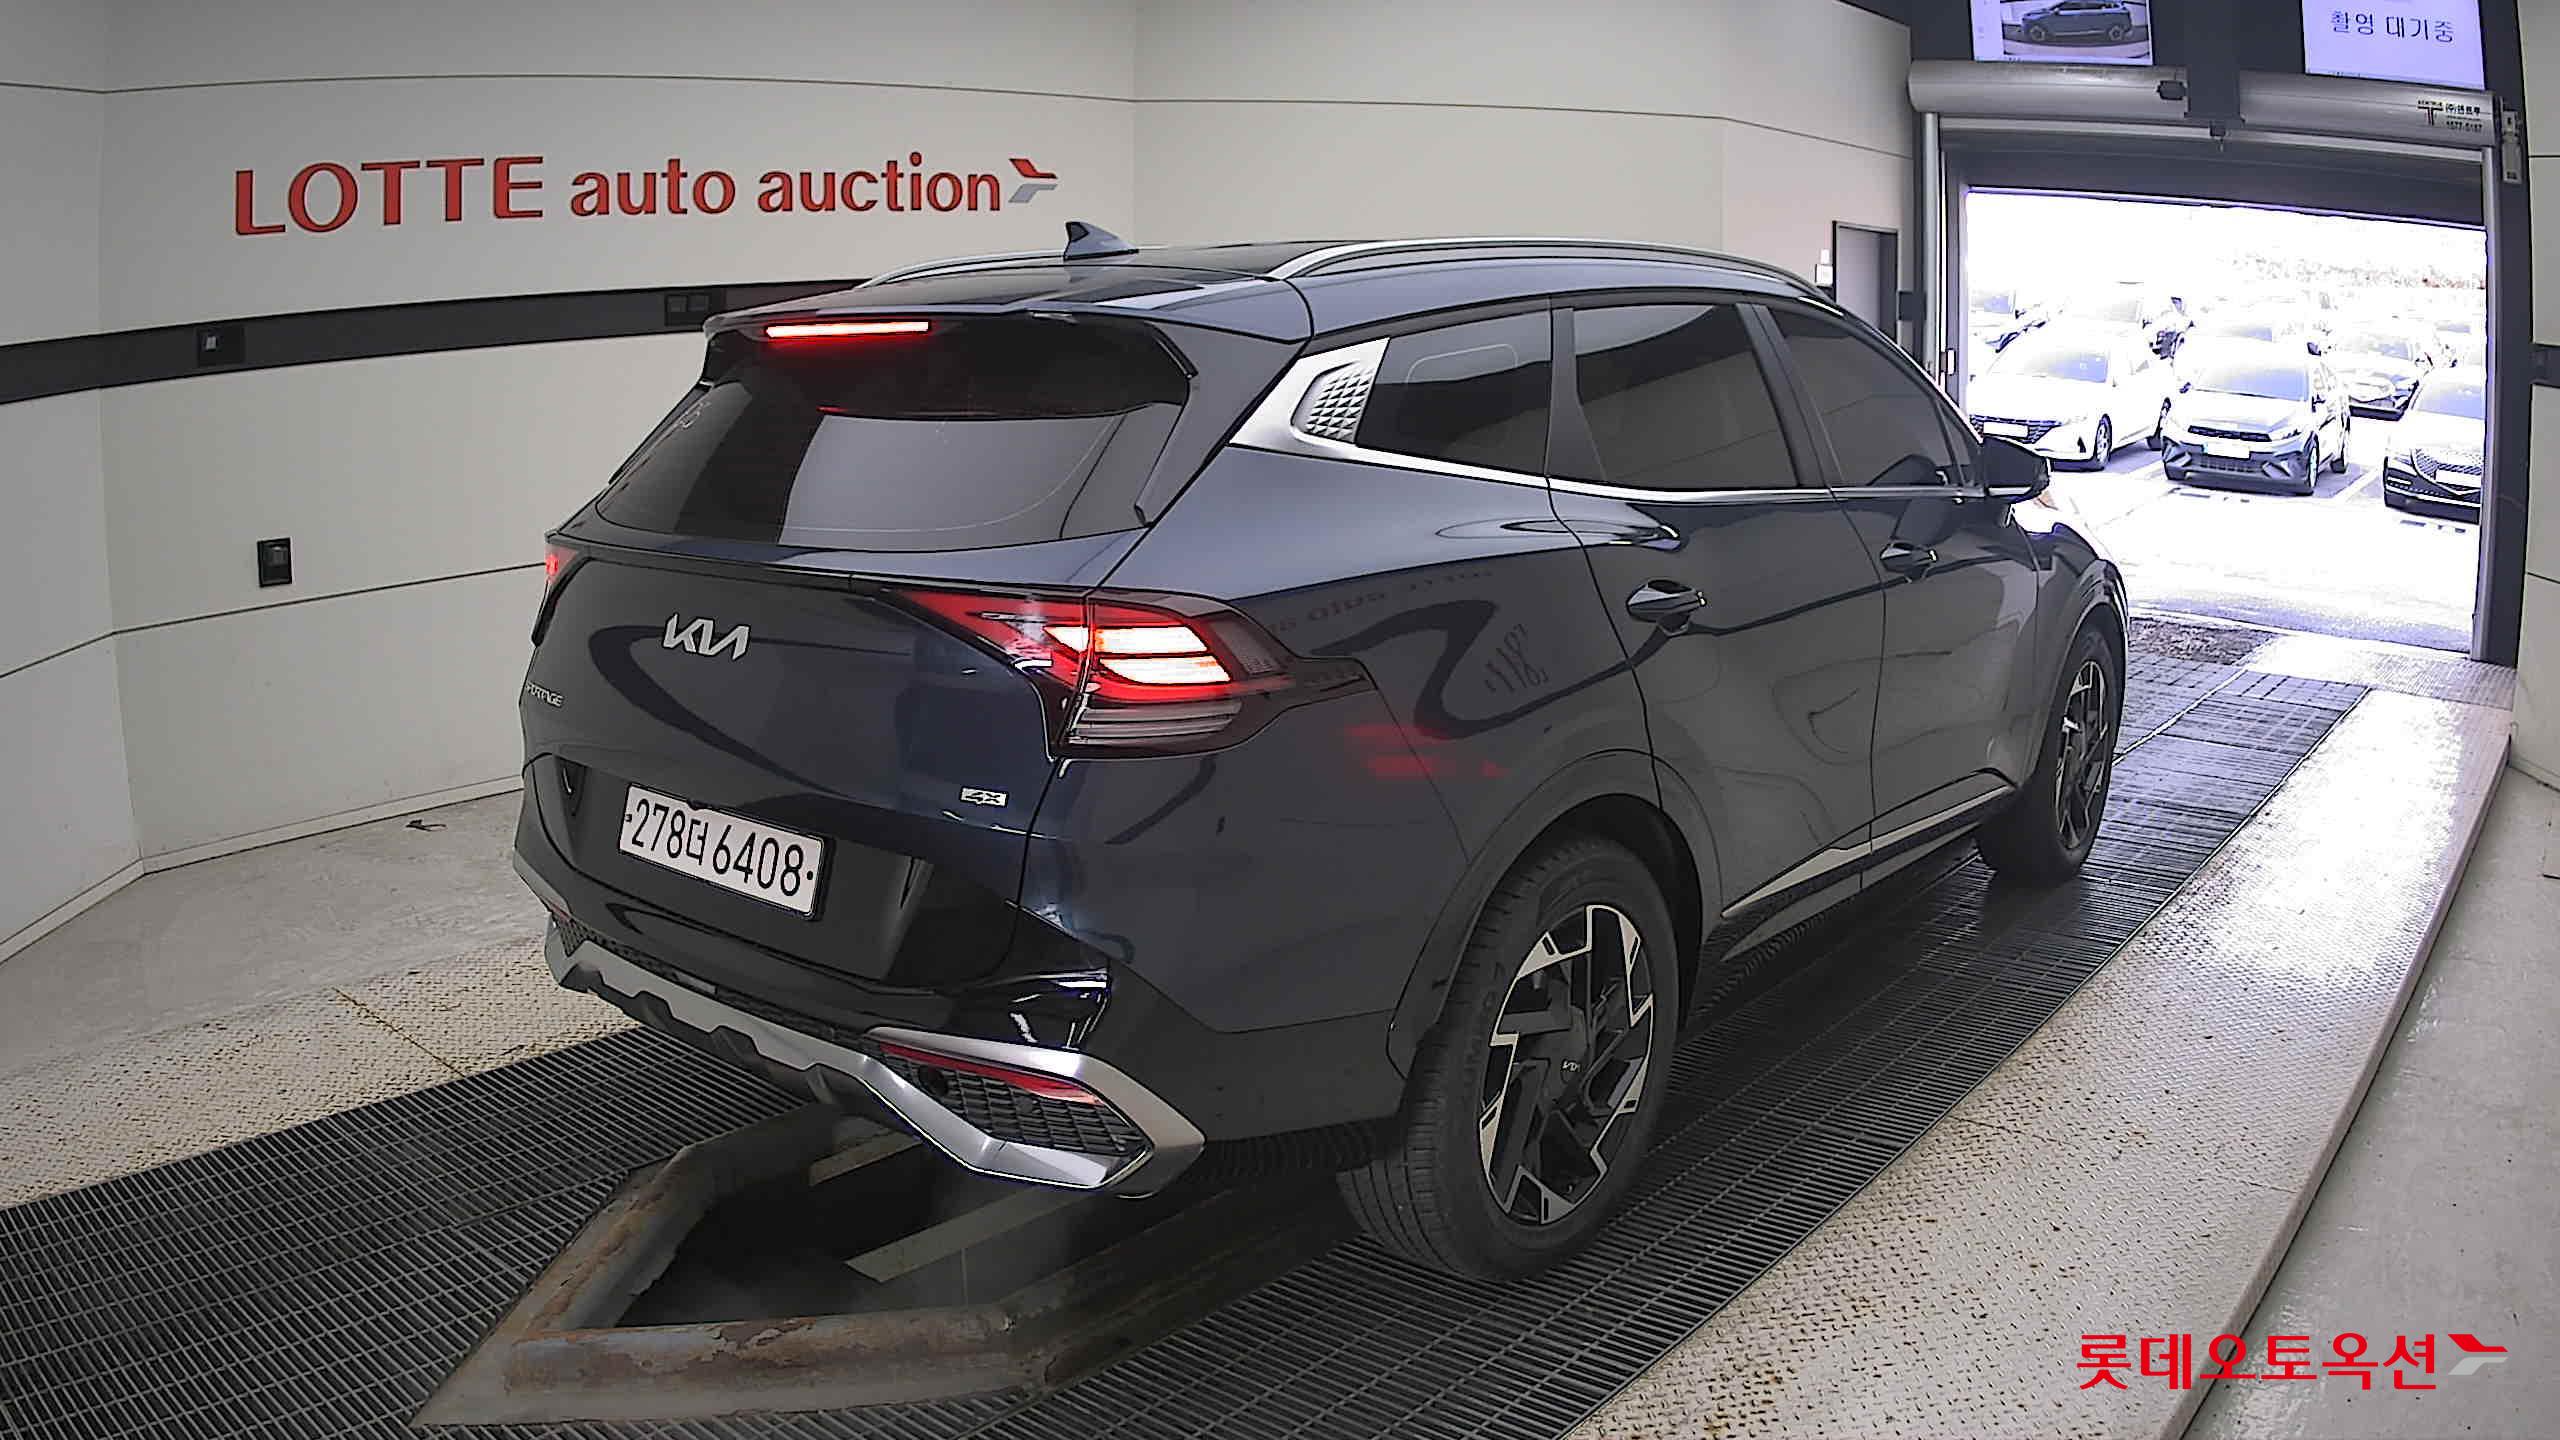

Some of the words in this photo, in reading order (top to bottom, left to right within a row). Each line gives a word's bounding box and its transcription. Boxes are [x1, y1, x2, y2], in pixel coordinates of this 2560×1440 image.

[2331, 10, 2374, 36] 촬영
[2386, 16, 2453, 43] 대기중
[236, 156, 543, 236] LOTTE
[570, 158, 736, 217] auto
[757, 151, 1001, 213] auction
[662, 613, 750, 660] KIA
[631, 798, 709, 866] 278더
[712, 824, 804, 896] 6408
